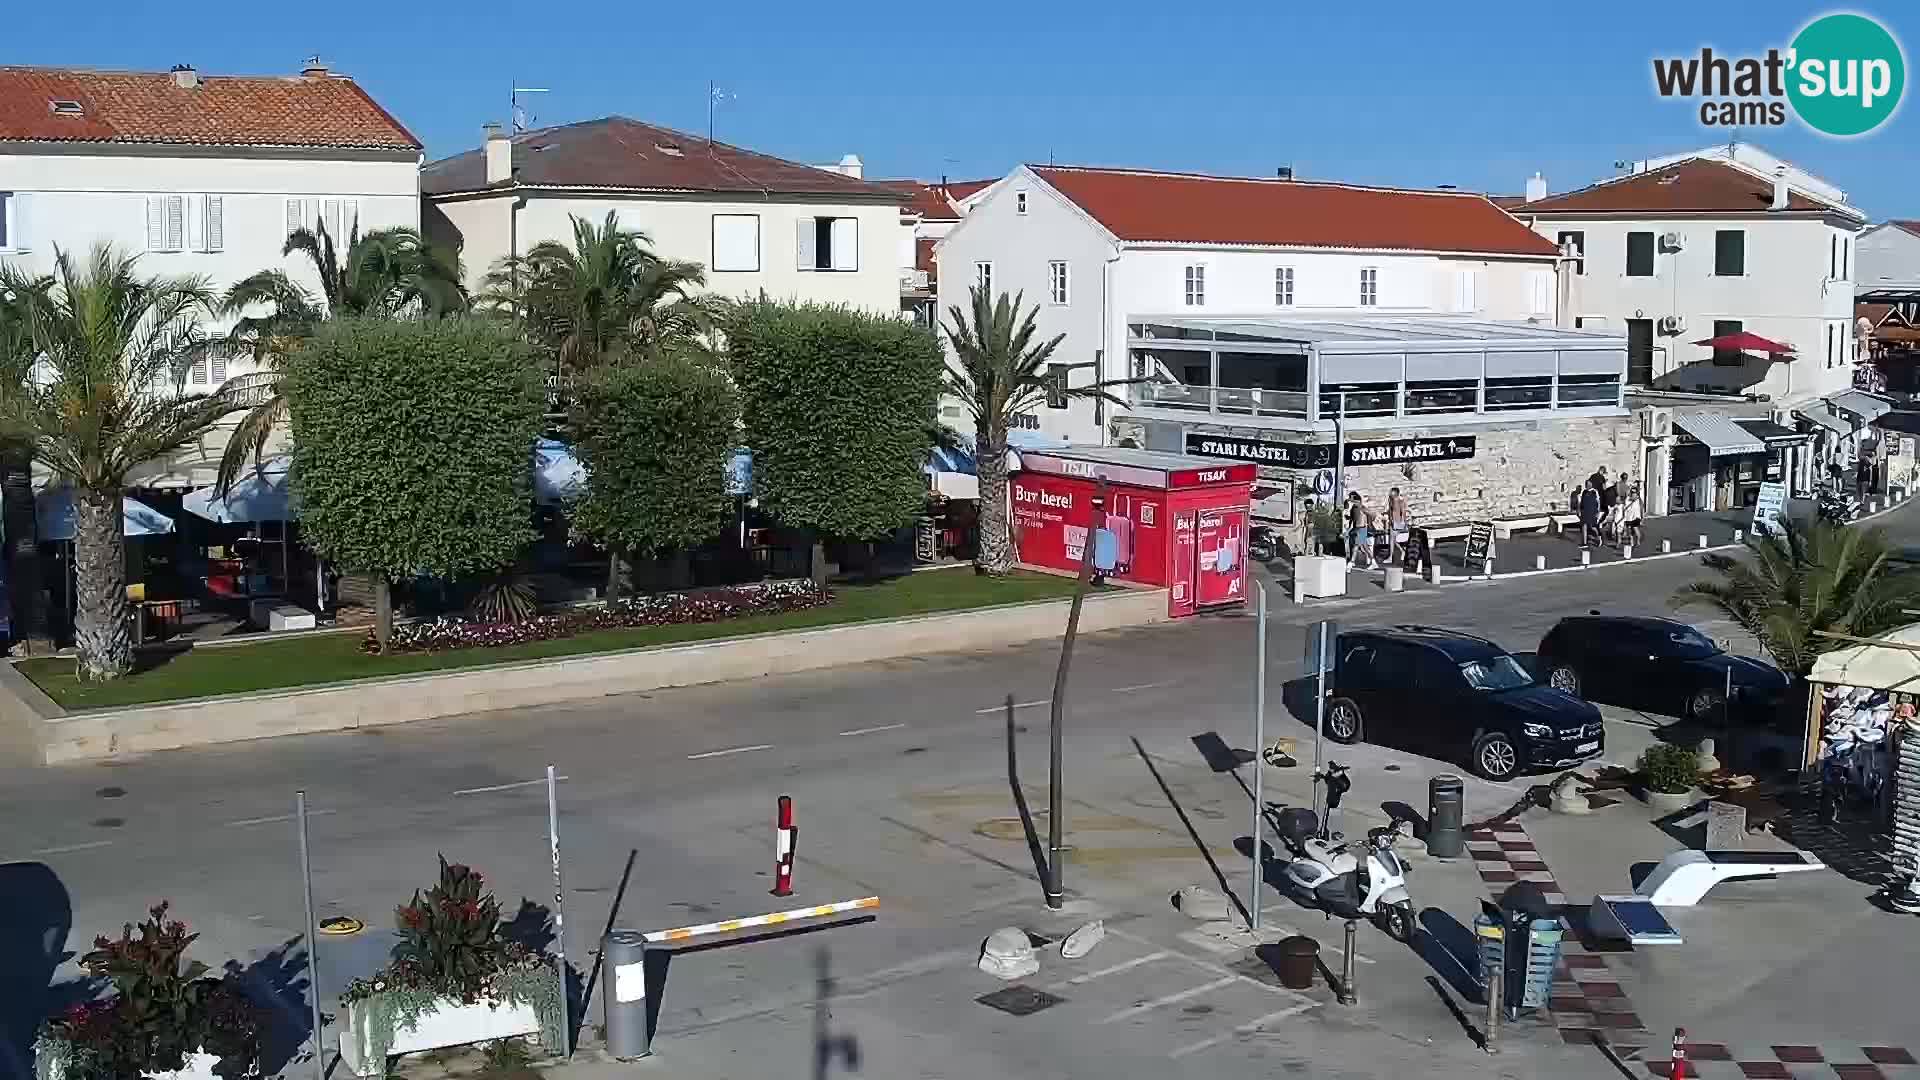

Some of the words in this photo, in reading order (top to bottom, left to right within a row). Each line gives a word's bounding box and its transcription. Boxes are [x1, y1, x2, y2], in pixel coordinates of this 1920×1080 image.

[1201, 441, 1238, 456] STARI
[1240, 443, 1290, 461] KAŠTEL
[1351, 446, 1392, 461] STARI
[1394, 440, 1444, 459] KAŠTEL
[1197, 469, 1227, 483] TISAK
[1015, 484, 1039, 504] Buy
[1041, 488, 1073, 509] here!
